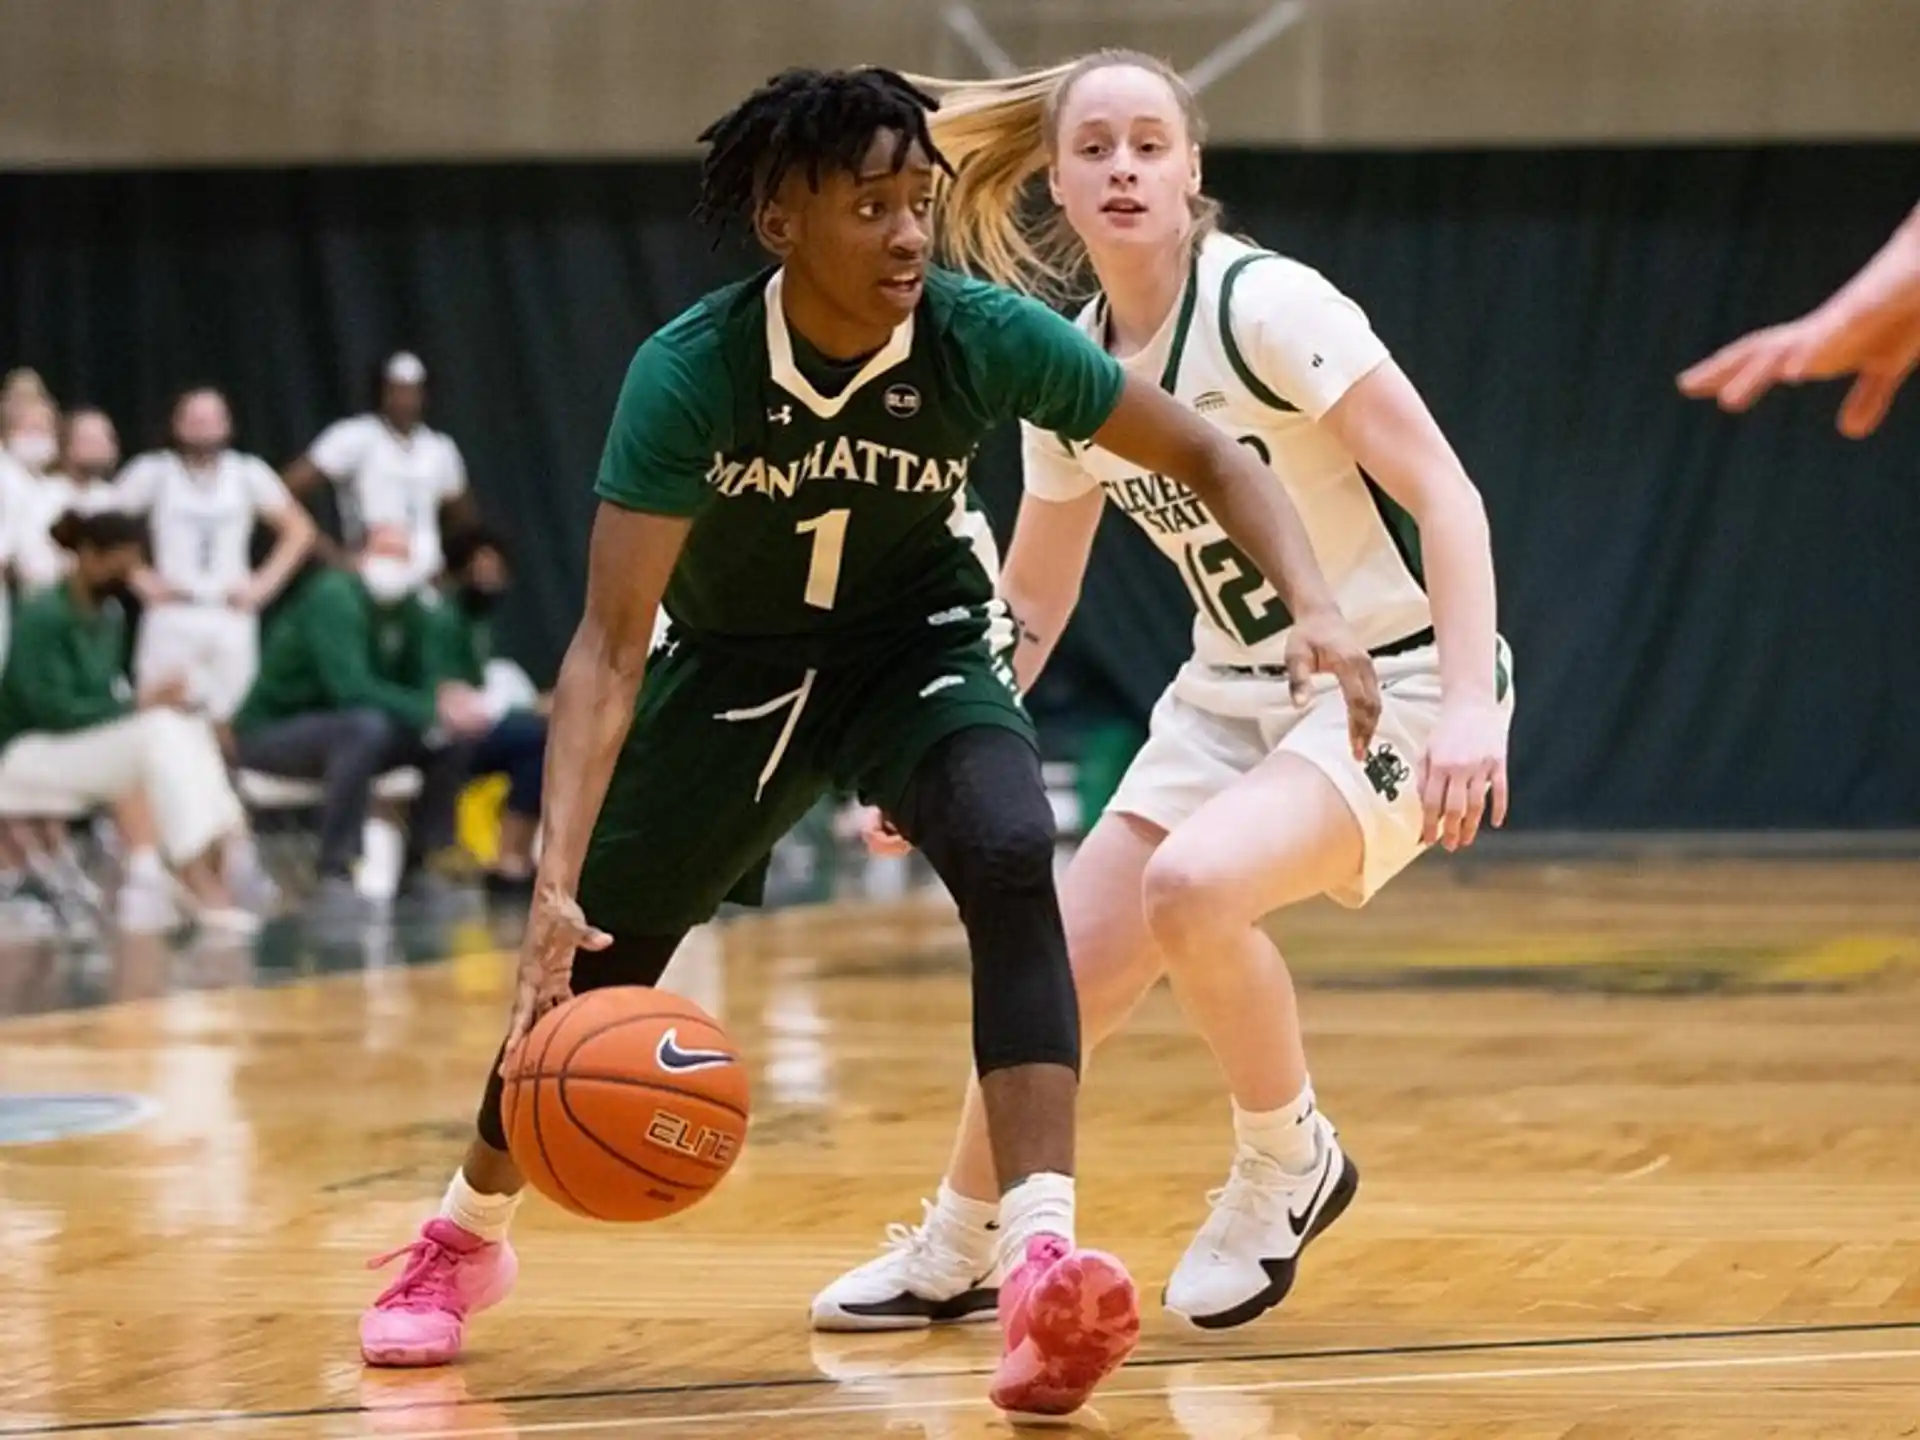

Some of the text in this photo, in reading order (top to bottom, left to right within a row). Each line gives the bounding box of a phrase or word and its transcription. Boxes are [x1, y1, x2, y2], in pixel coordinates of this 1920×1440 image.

[705, 435, 967, 501] MANHATTAN
[795, 508, 851, 610] 1
[644, 1108, 736, 1164] ELITE
